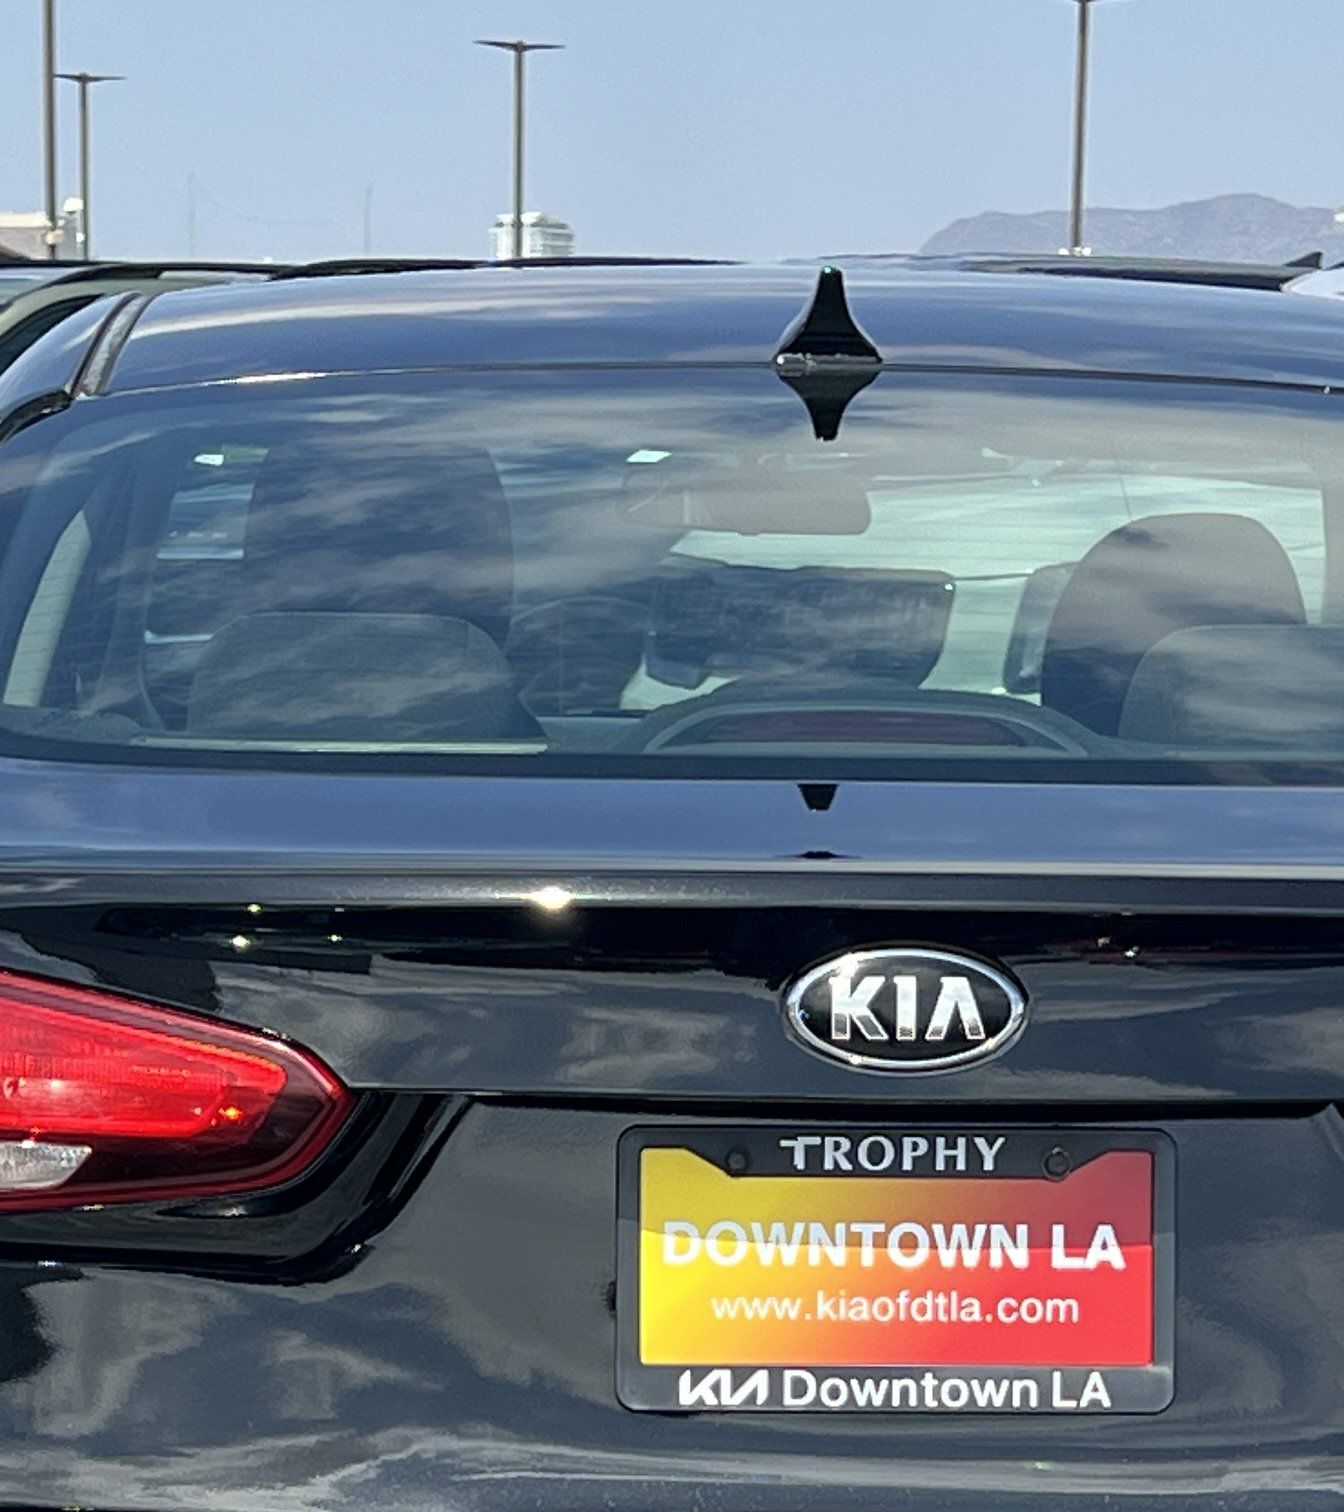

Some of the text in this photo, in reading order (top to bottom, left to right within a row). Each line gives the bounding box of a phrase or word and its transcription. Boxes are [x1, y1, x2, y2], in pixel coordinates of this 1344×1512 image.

[827, 975, 987, 1041] KIA
[780, 1136, 1006, 1172] TROPHY
[662, 1221, 1126, 1270] DOWNTOWN LA
[710, 1288, 1080, 1325] www.kiaofdtla.com
[678, 1369, 1112, 1408] KIA Downtown LA
